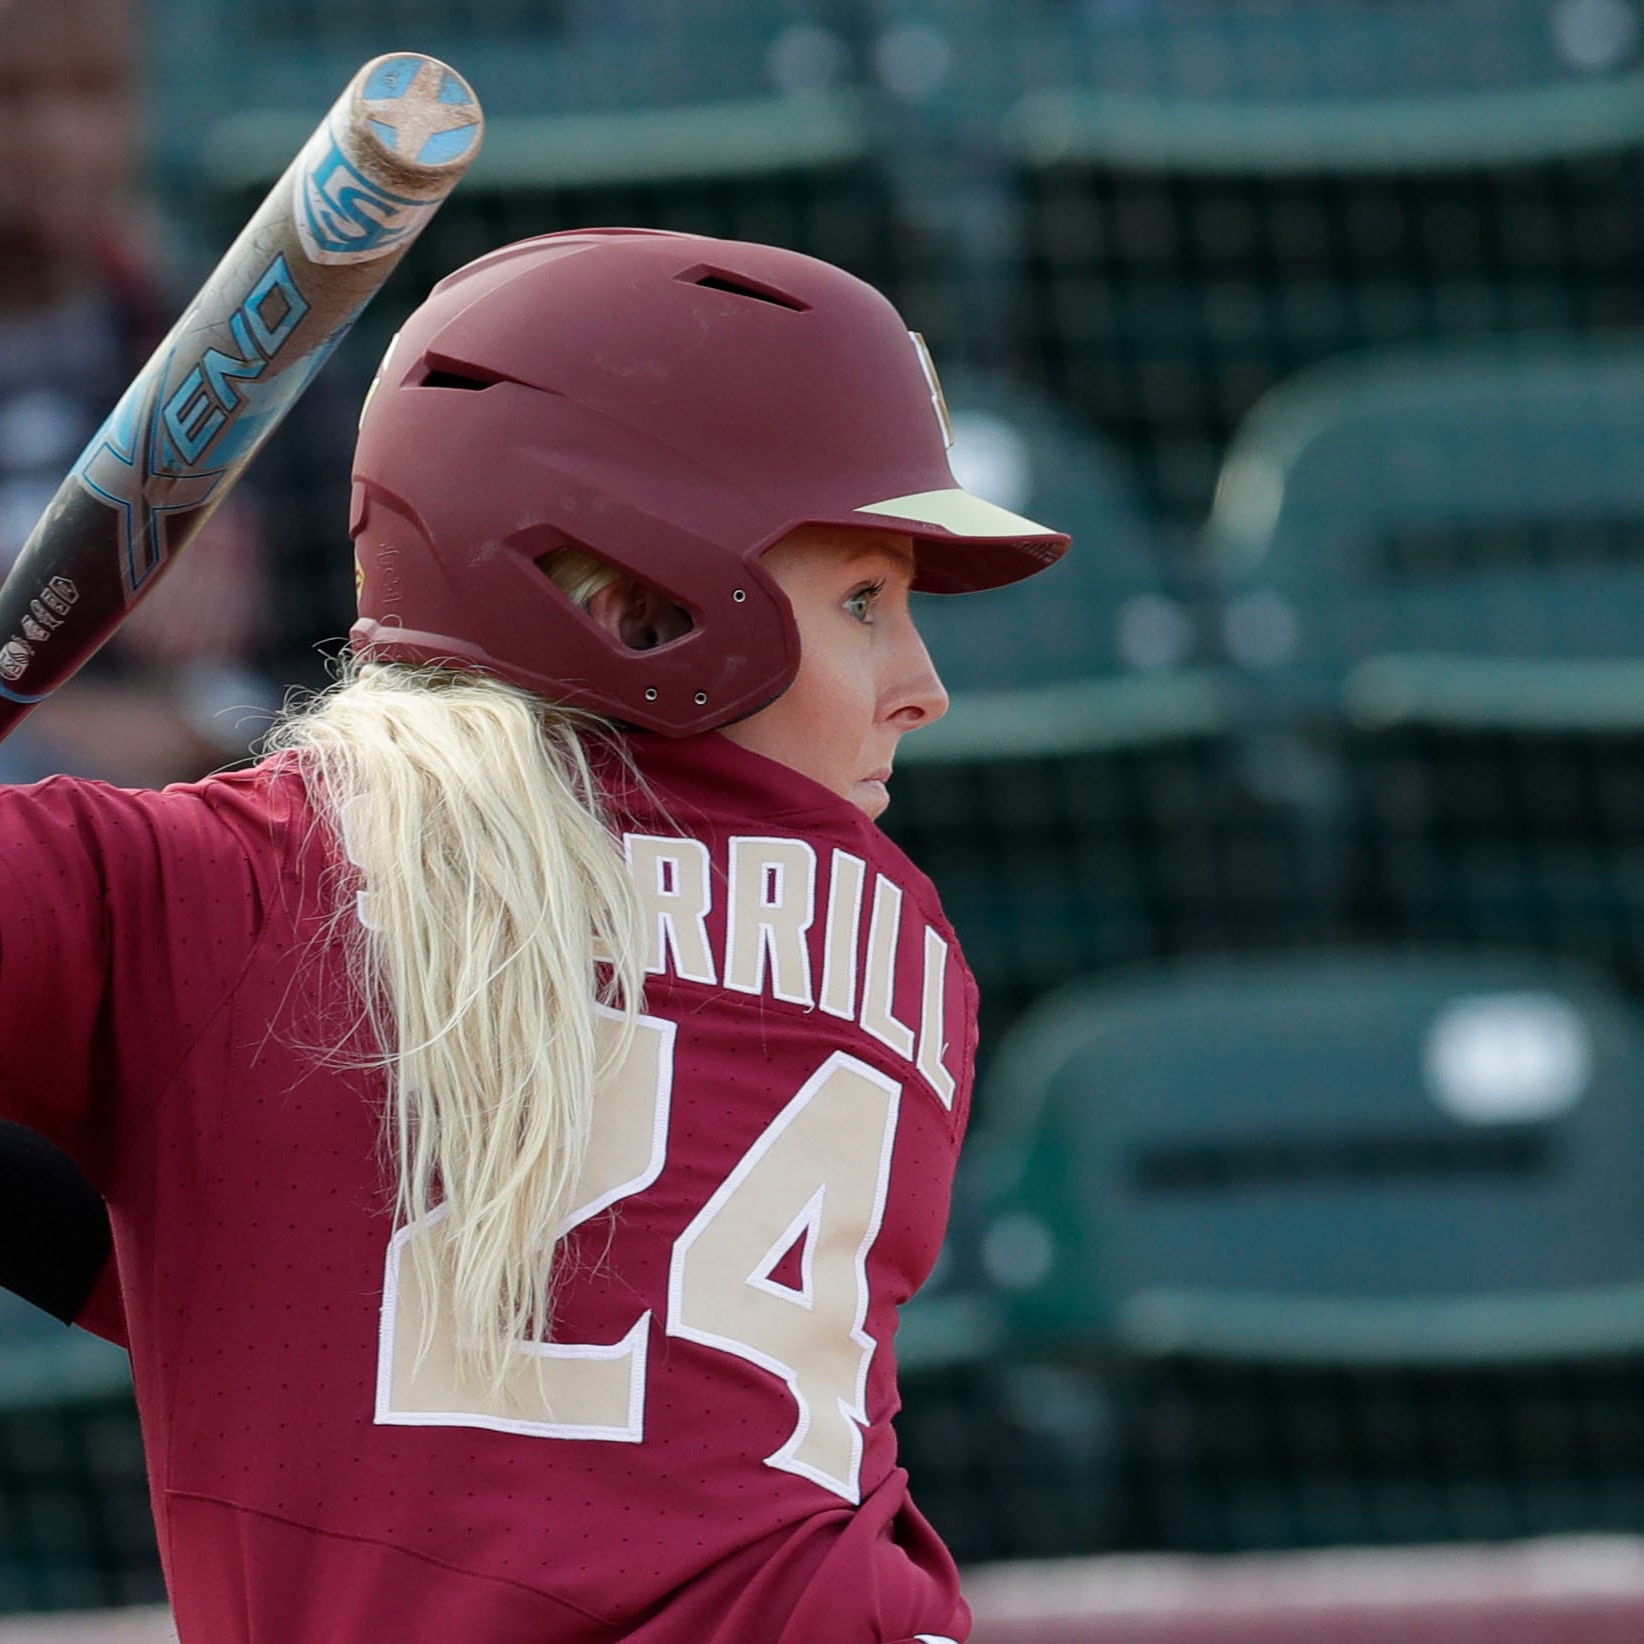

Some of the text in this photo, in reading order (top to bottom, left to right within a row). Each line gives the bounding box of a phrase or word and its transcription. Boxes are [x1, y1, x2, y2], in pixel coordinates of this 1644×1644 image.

[82, 252, 311, 596] XENO
[590, 832, 957, 1112] RRILL
[373, 1003, 901, 1506] 24
